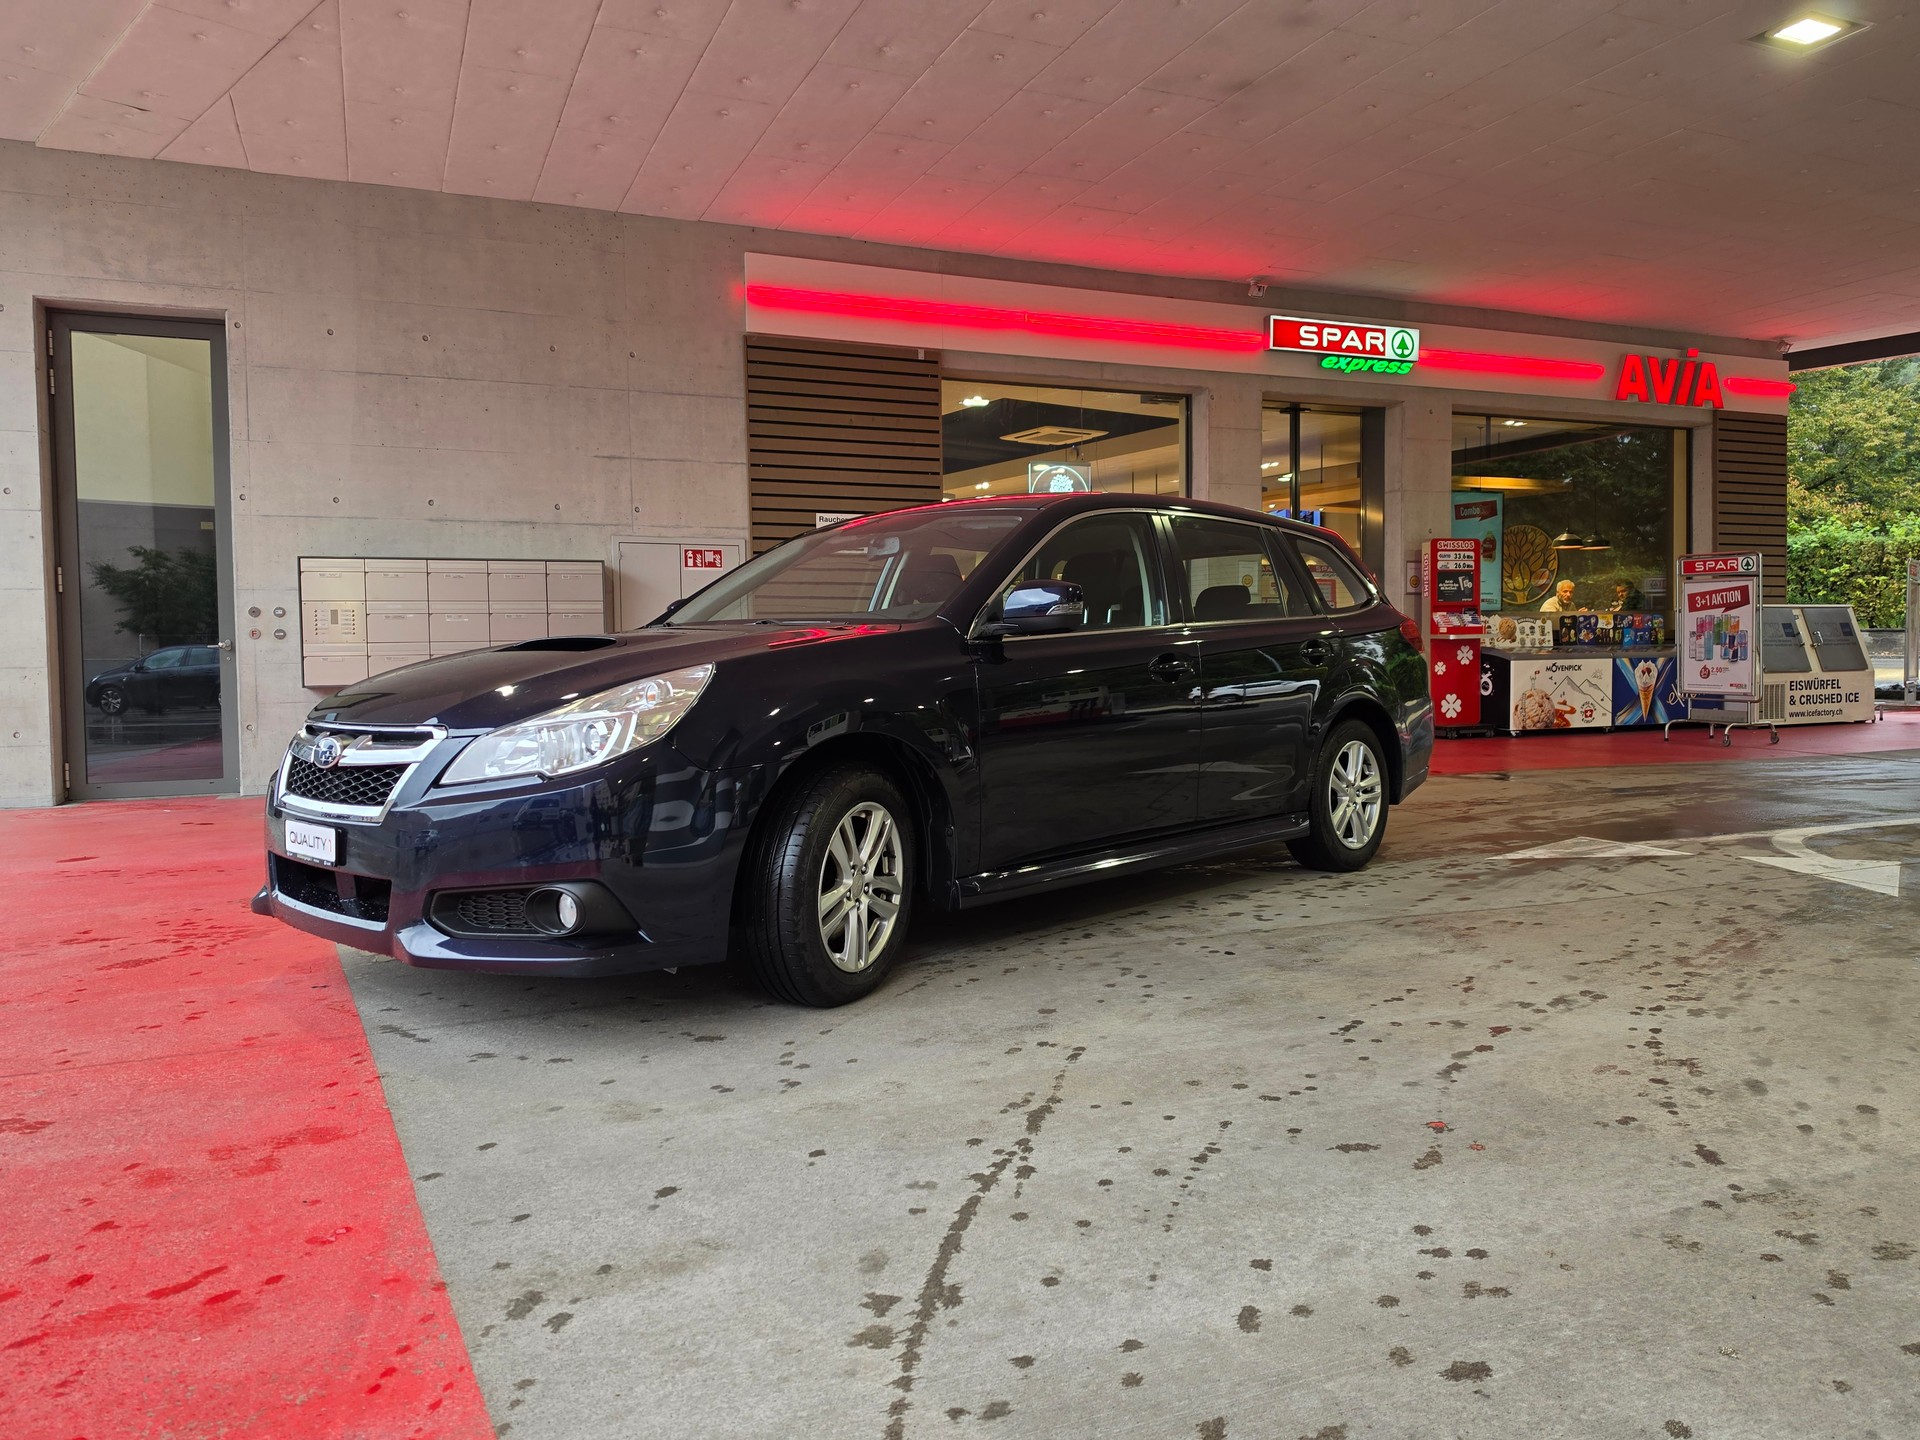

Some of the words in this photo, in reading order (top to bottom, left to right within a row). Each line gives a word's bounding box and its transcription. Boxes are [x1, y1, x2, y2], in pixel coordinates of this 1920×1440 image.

[1299, 325, 1385, 352] SPAR
[1321, 355, 1413, 374] express
[1438, 541, 1474, 549] SWISSLOS
[1695, 560, 1738, 571] SPAR
[1695, 594, 1710, 608] 3+1
[1711, 590, 1741, 605] AKTION
[1789, 677, 1841, 691] EISWÜRFEL
[1789, 695, 1796, 706] &
[1799, 693, 1843, 705] CRUSHED
[1845, 692, 1860, 703] ICE
[1789, 708, 1843, 718] www.icefactory.ch
